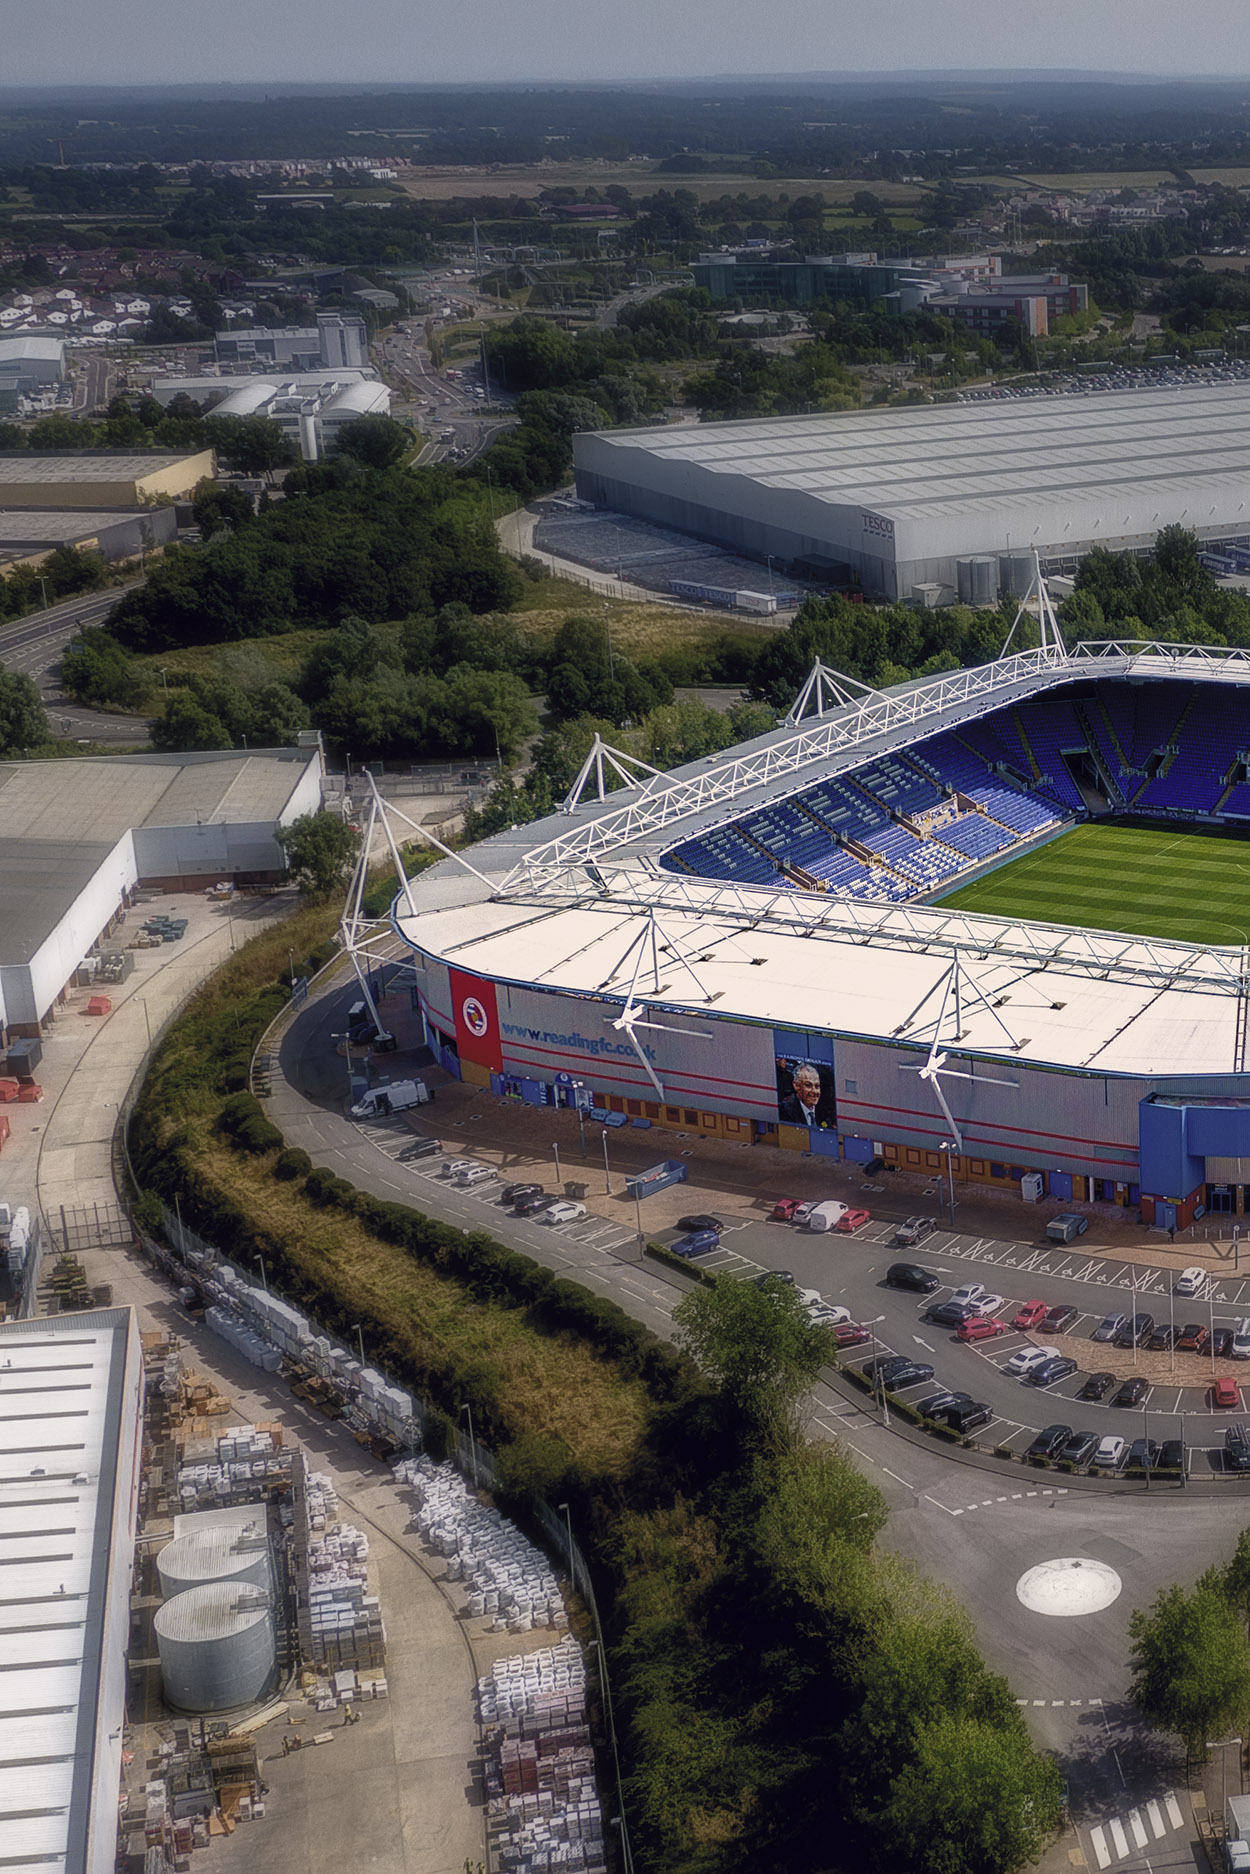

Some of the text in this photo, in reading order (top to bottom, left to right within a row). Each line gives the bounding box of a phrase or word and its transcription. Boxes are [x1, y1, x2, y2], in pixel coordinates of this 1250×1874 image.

[862, 514, 893, 533] TESCO
[671, 583, 697, 595] TESCO
[704, 589, 730, 600] TESCO
[502, 1022, 656, 1060] www.readingfc.co.k
